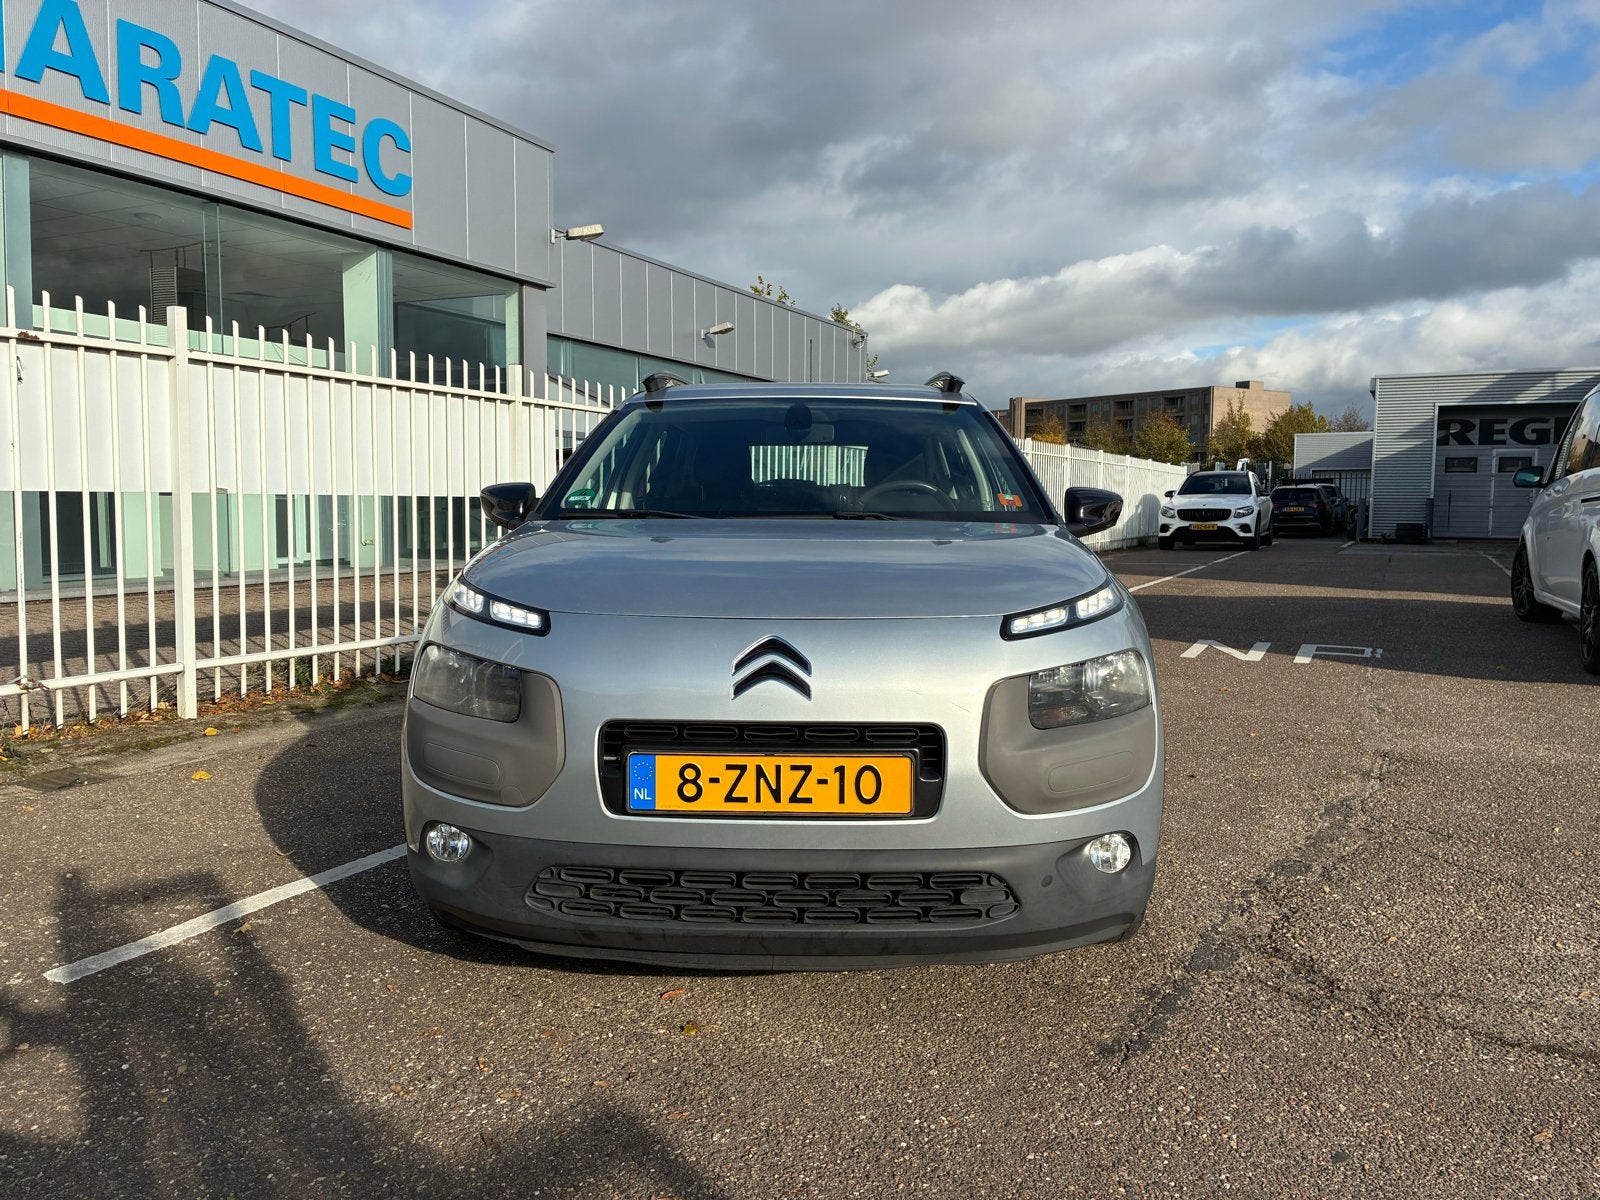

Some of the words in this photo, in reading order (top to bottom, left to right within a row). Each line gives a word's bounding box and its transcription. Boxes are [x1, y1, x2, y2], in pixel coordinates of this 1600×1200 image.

[0, 0, 412, 197] ARATEC
[634, 787, 652, 800] NL
[676, 763, 882, 805] 8-ZNZ-10
